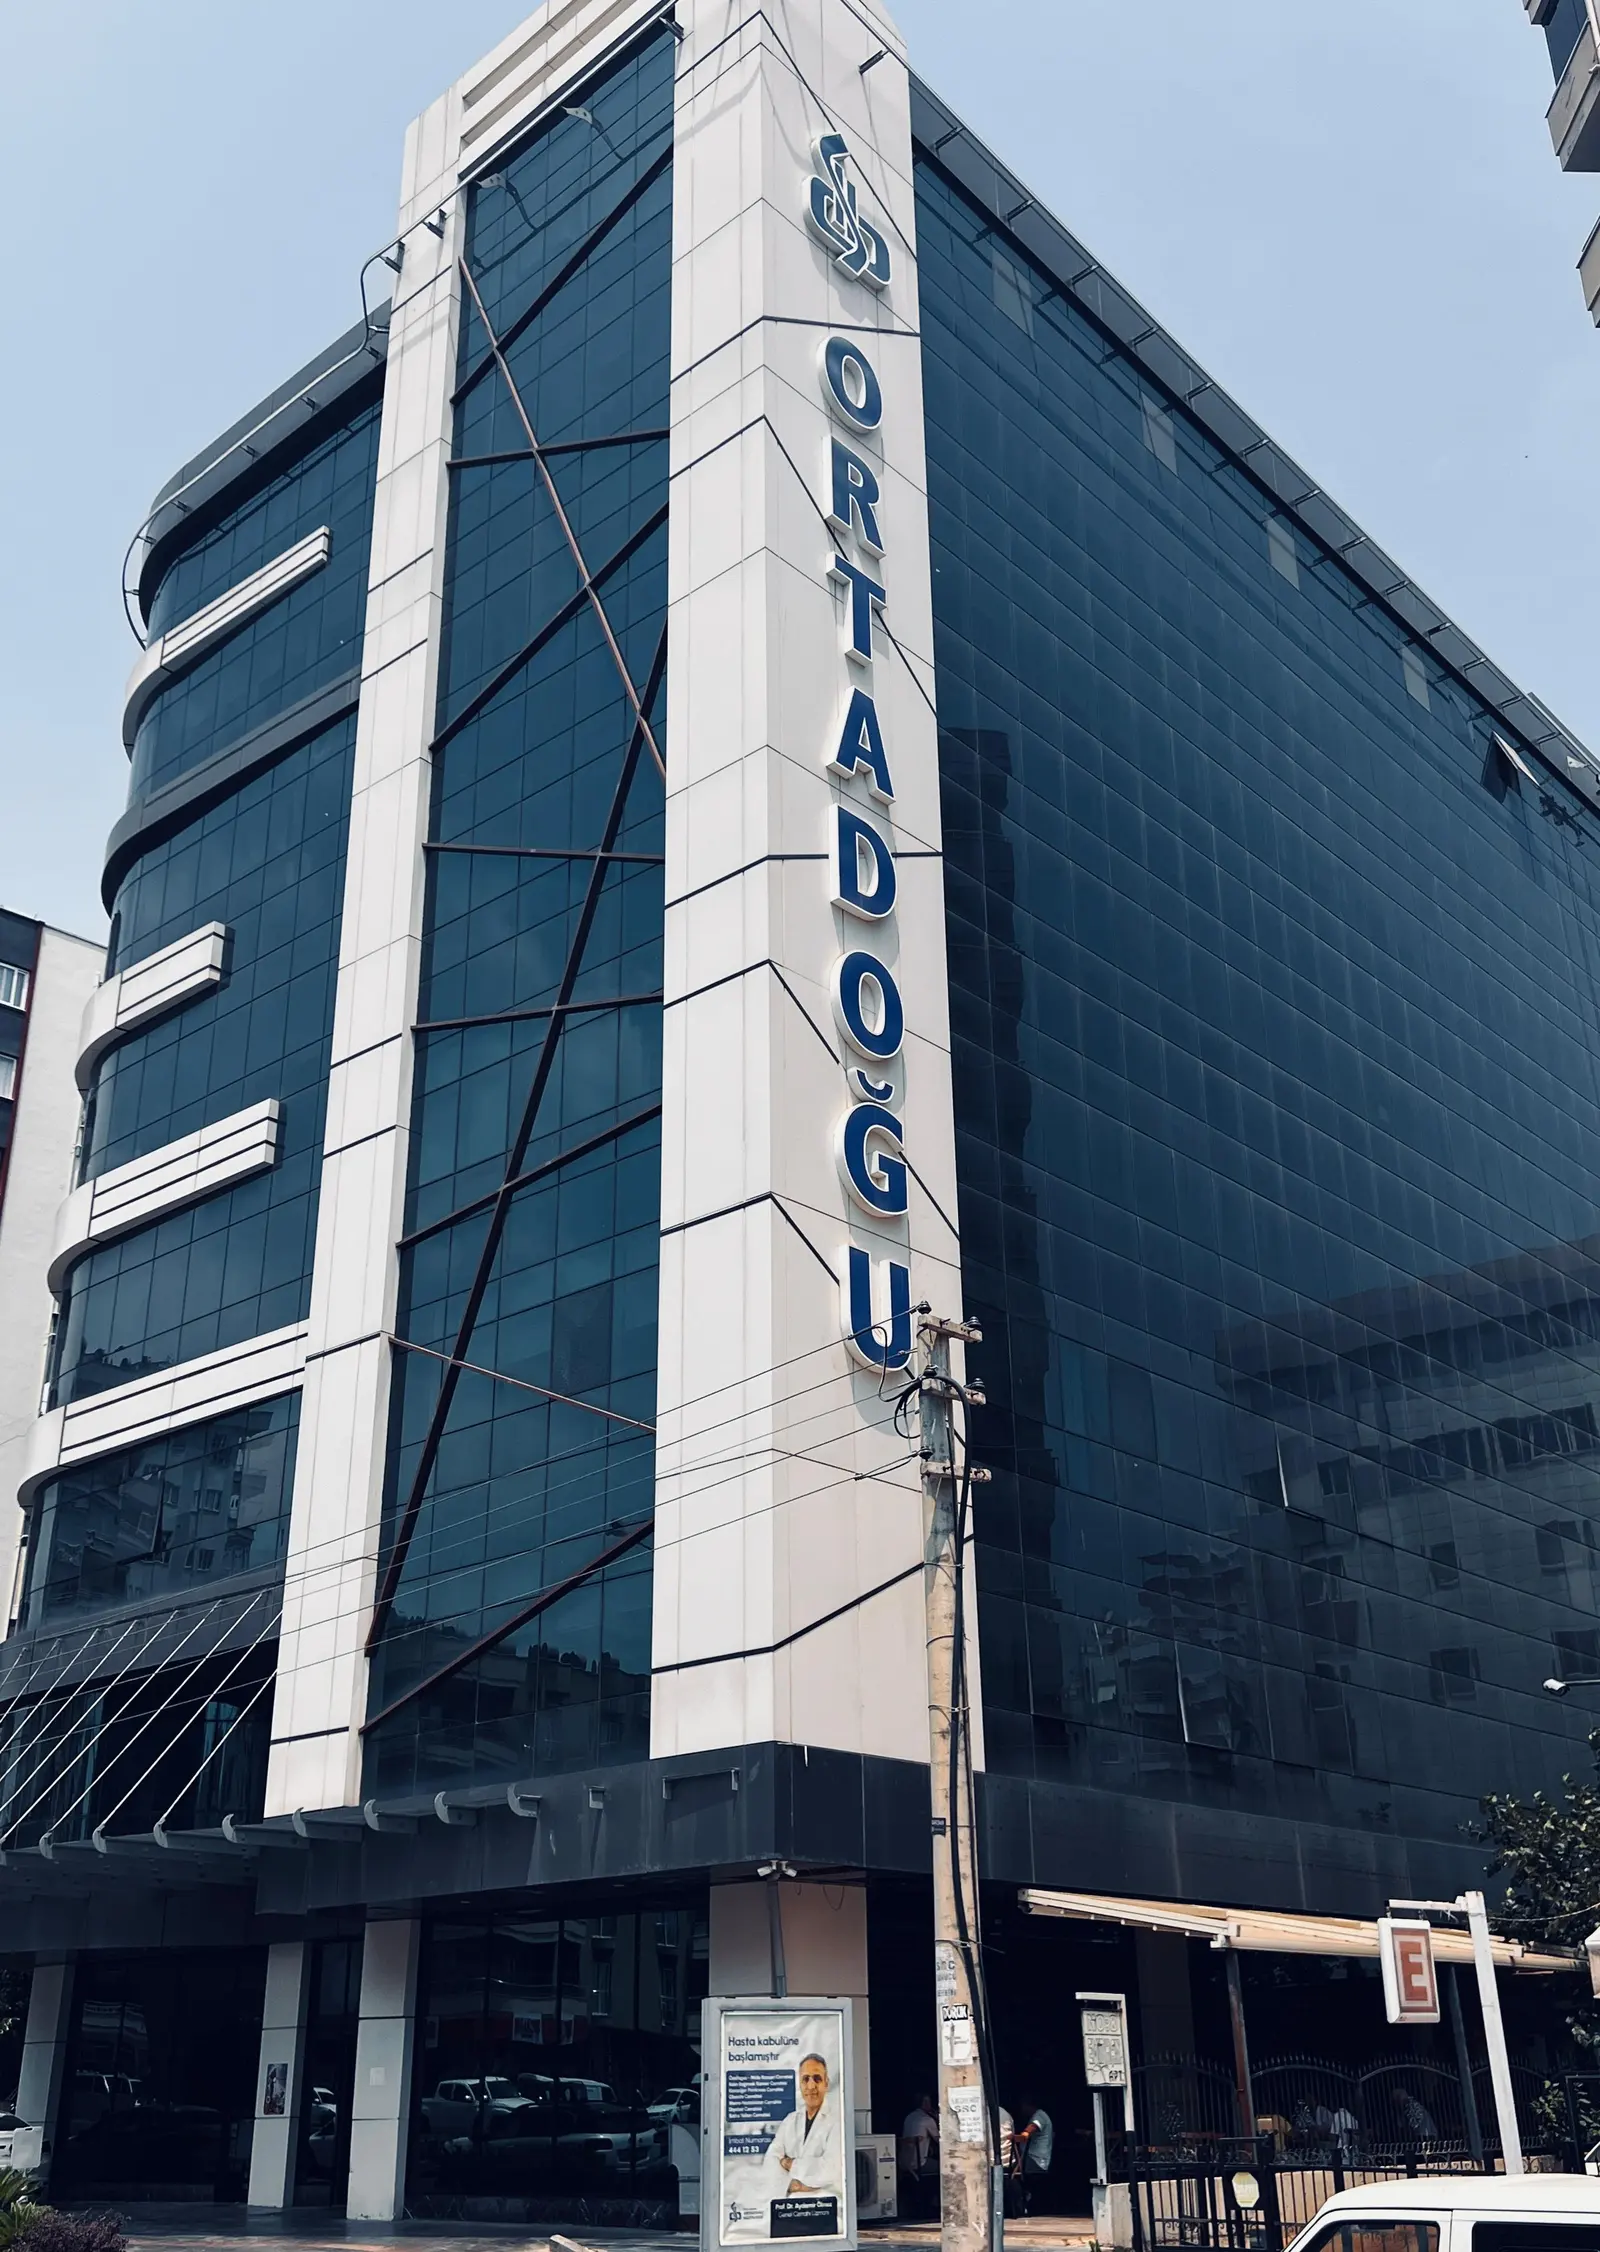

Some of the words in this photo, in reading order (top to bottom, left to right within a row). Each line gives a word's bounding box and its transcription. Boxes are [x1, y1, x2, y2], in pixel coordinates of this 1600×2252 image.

[818, 336, 911, 1371] ORTADOĞU
[1397, 1938, 1430, 2003] E
[728, 2036, 755, 2046] Hasta
[757, 2035, 799, 2045] kabulüne
[728, 2051, 780, 2063] başlamıştır
